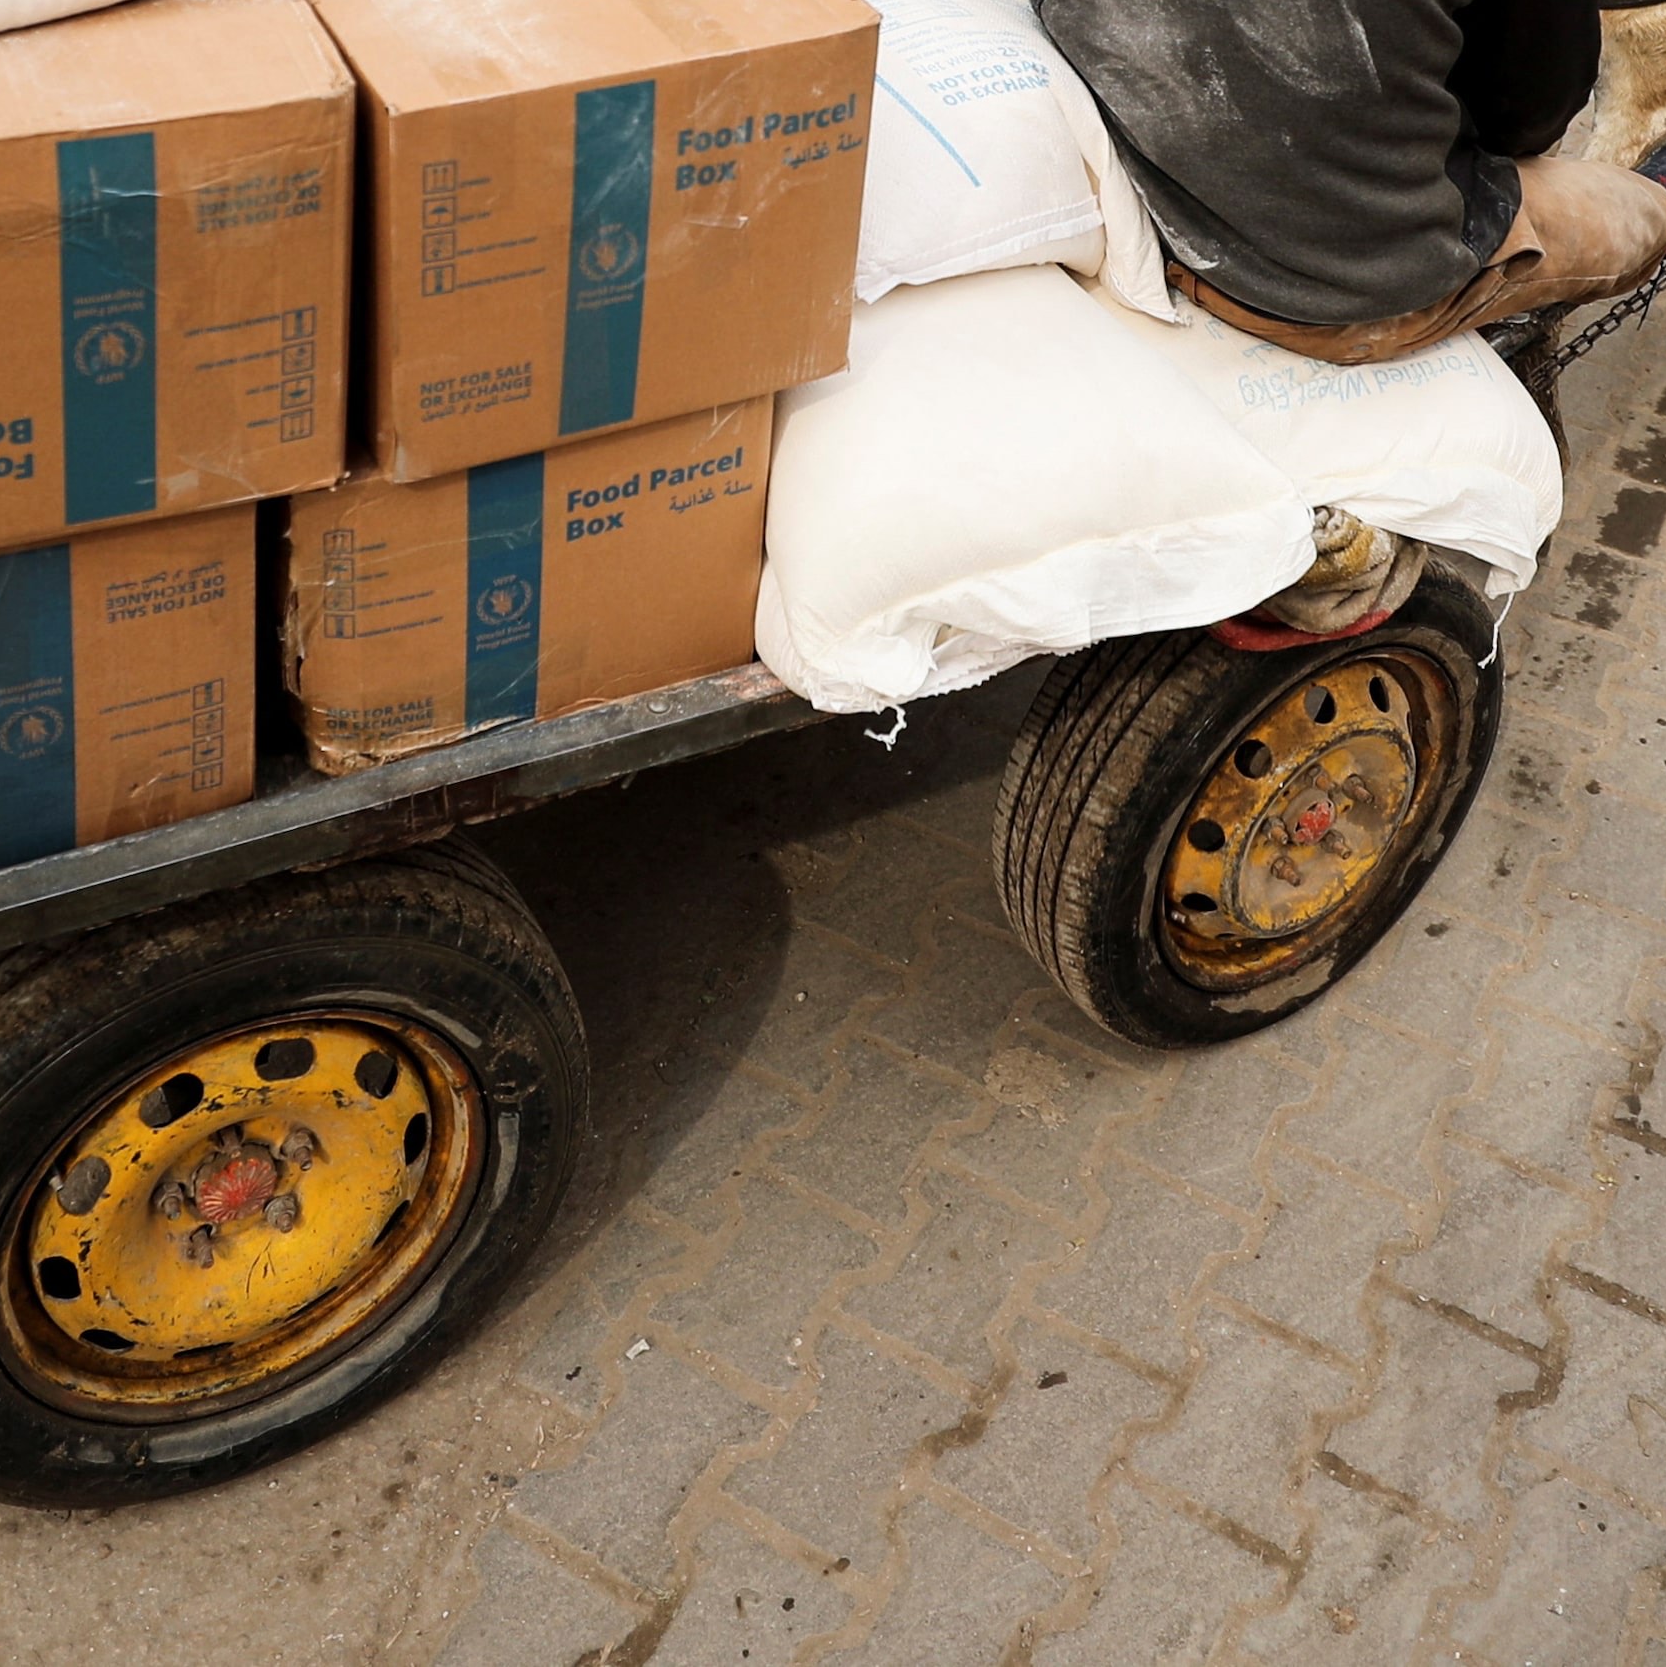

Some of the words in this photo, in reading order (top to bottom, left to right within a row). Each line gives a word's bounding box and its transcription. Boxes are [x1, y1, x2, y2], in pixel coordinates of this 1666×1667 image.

[928, 74, 968, 94] NOT
[970, 64, 1007, 83] FOR
[942, 91, 972, 106] OR
[972, 75, 1049, 100] EXCHAN
[676, 117, 753, 156] Food
[762, 94, 857, 139] Parcel
[675, 160, 737, 192] Box
[420, 378, 456, 395] NOT
[460, 371, 491, 388] FOR
[496, 360, 532, 380] SALE
[1374, 354, 1478, 387] Fortified
[420, 395, 444, 409] OR
[448, 375, 532, 404] EXCHANGE
[567, 474, 640, 513] Food
[649, 448, 743, 491] Parcel
[566, 511, 624, 542] Box
[106, 580, 196, 610] EXCHANGE
[189, 587, 225, 608] NOT
[200, 574, 225, 592] OR
[107, 606, 146, 624] SALE
[152, 596, 185, 615] FOR
